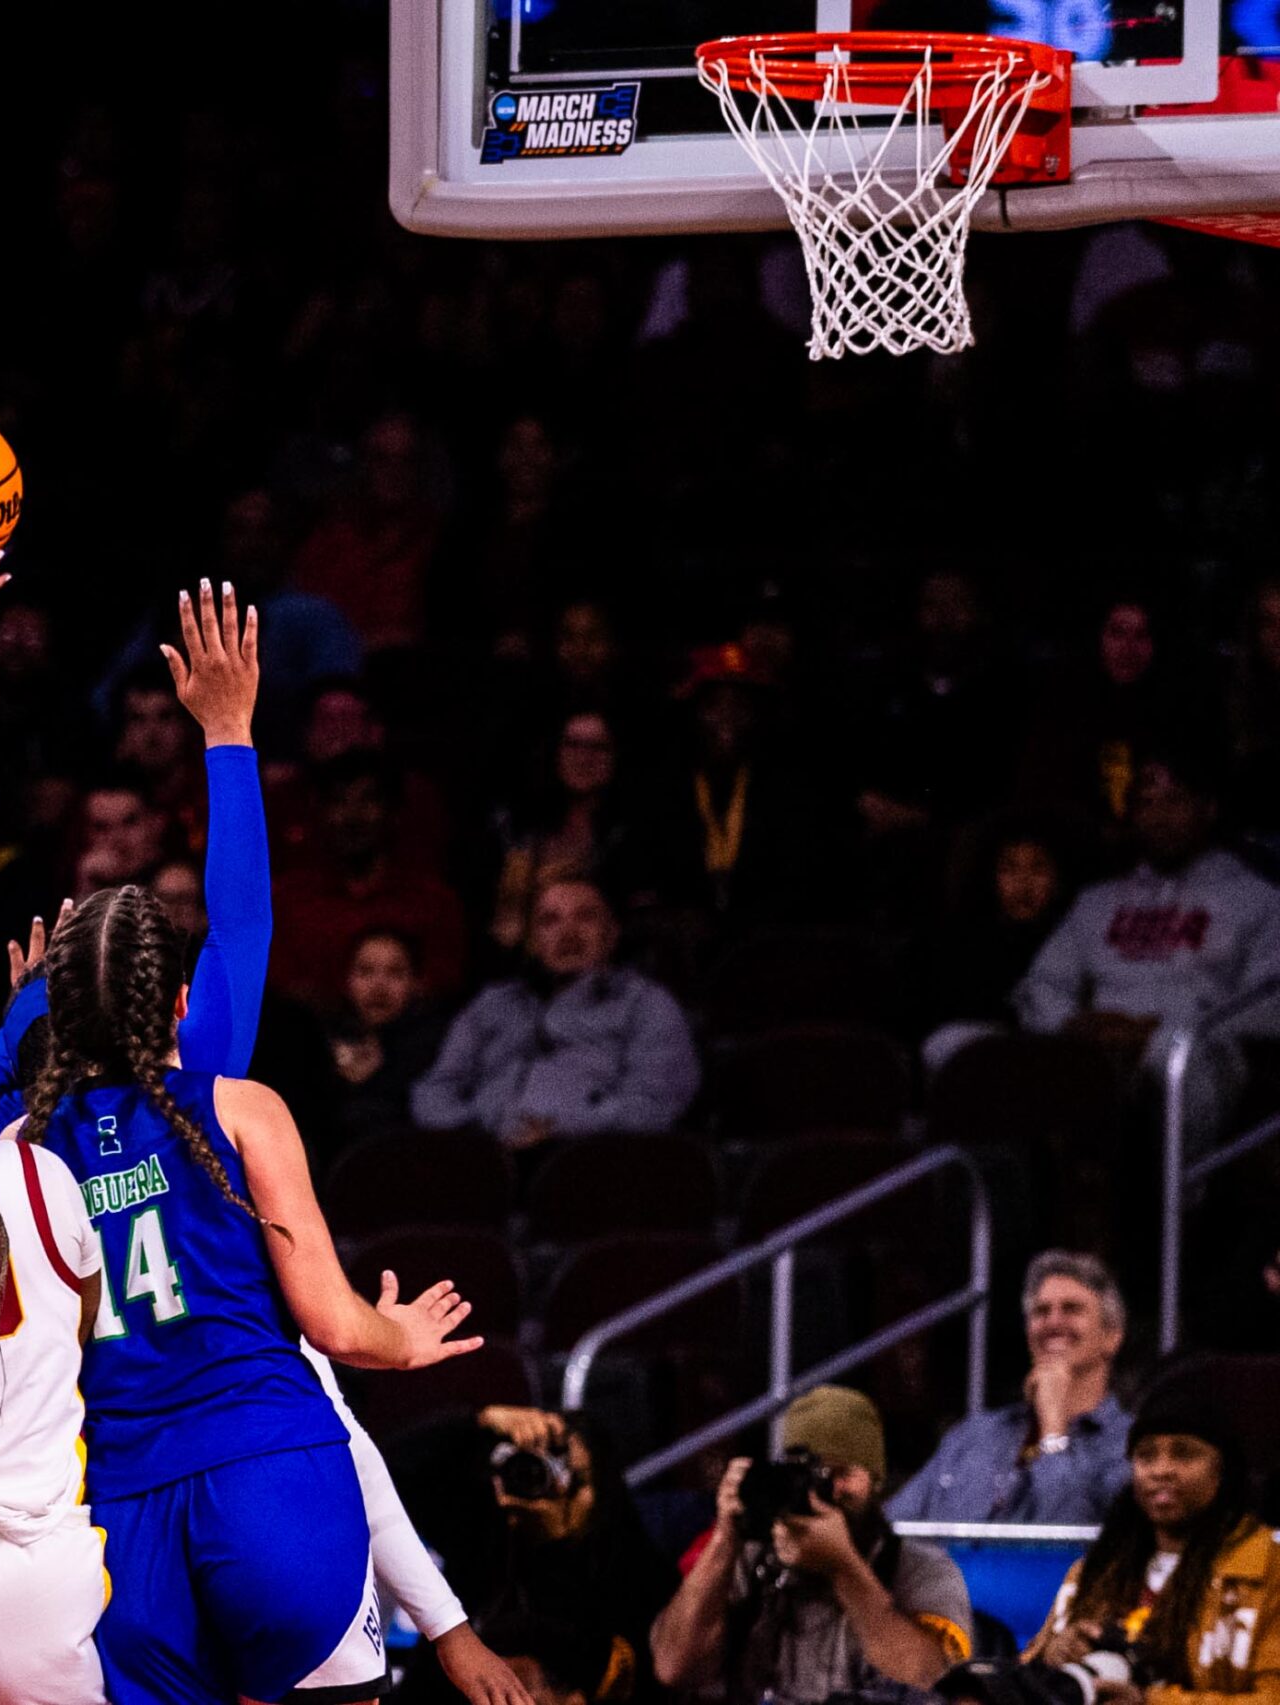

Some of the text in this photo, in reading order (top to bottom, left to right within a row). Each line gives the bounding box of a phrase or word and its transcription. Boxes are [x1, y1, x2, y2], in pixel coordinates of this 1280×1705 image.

[516, 93, 596, 122] MARCH
[525, 119, 632, 149] MADNESS
[90, 1204, 190, 1343] 14
